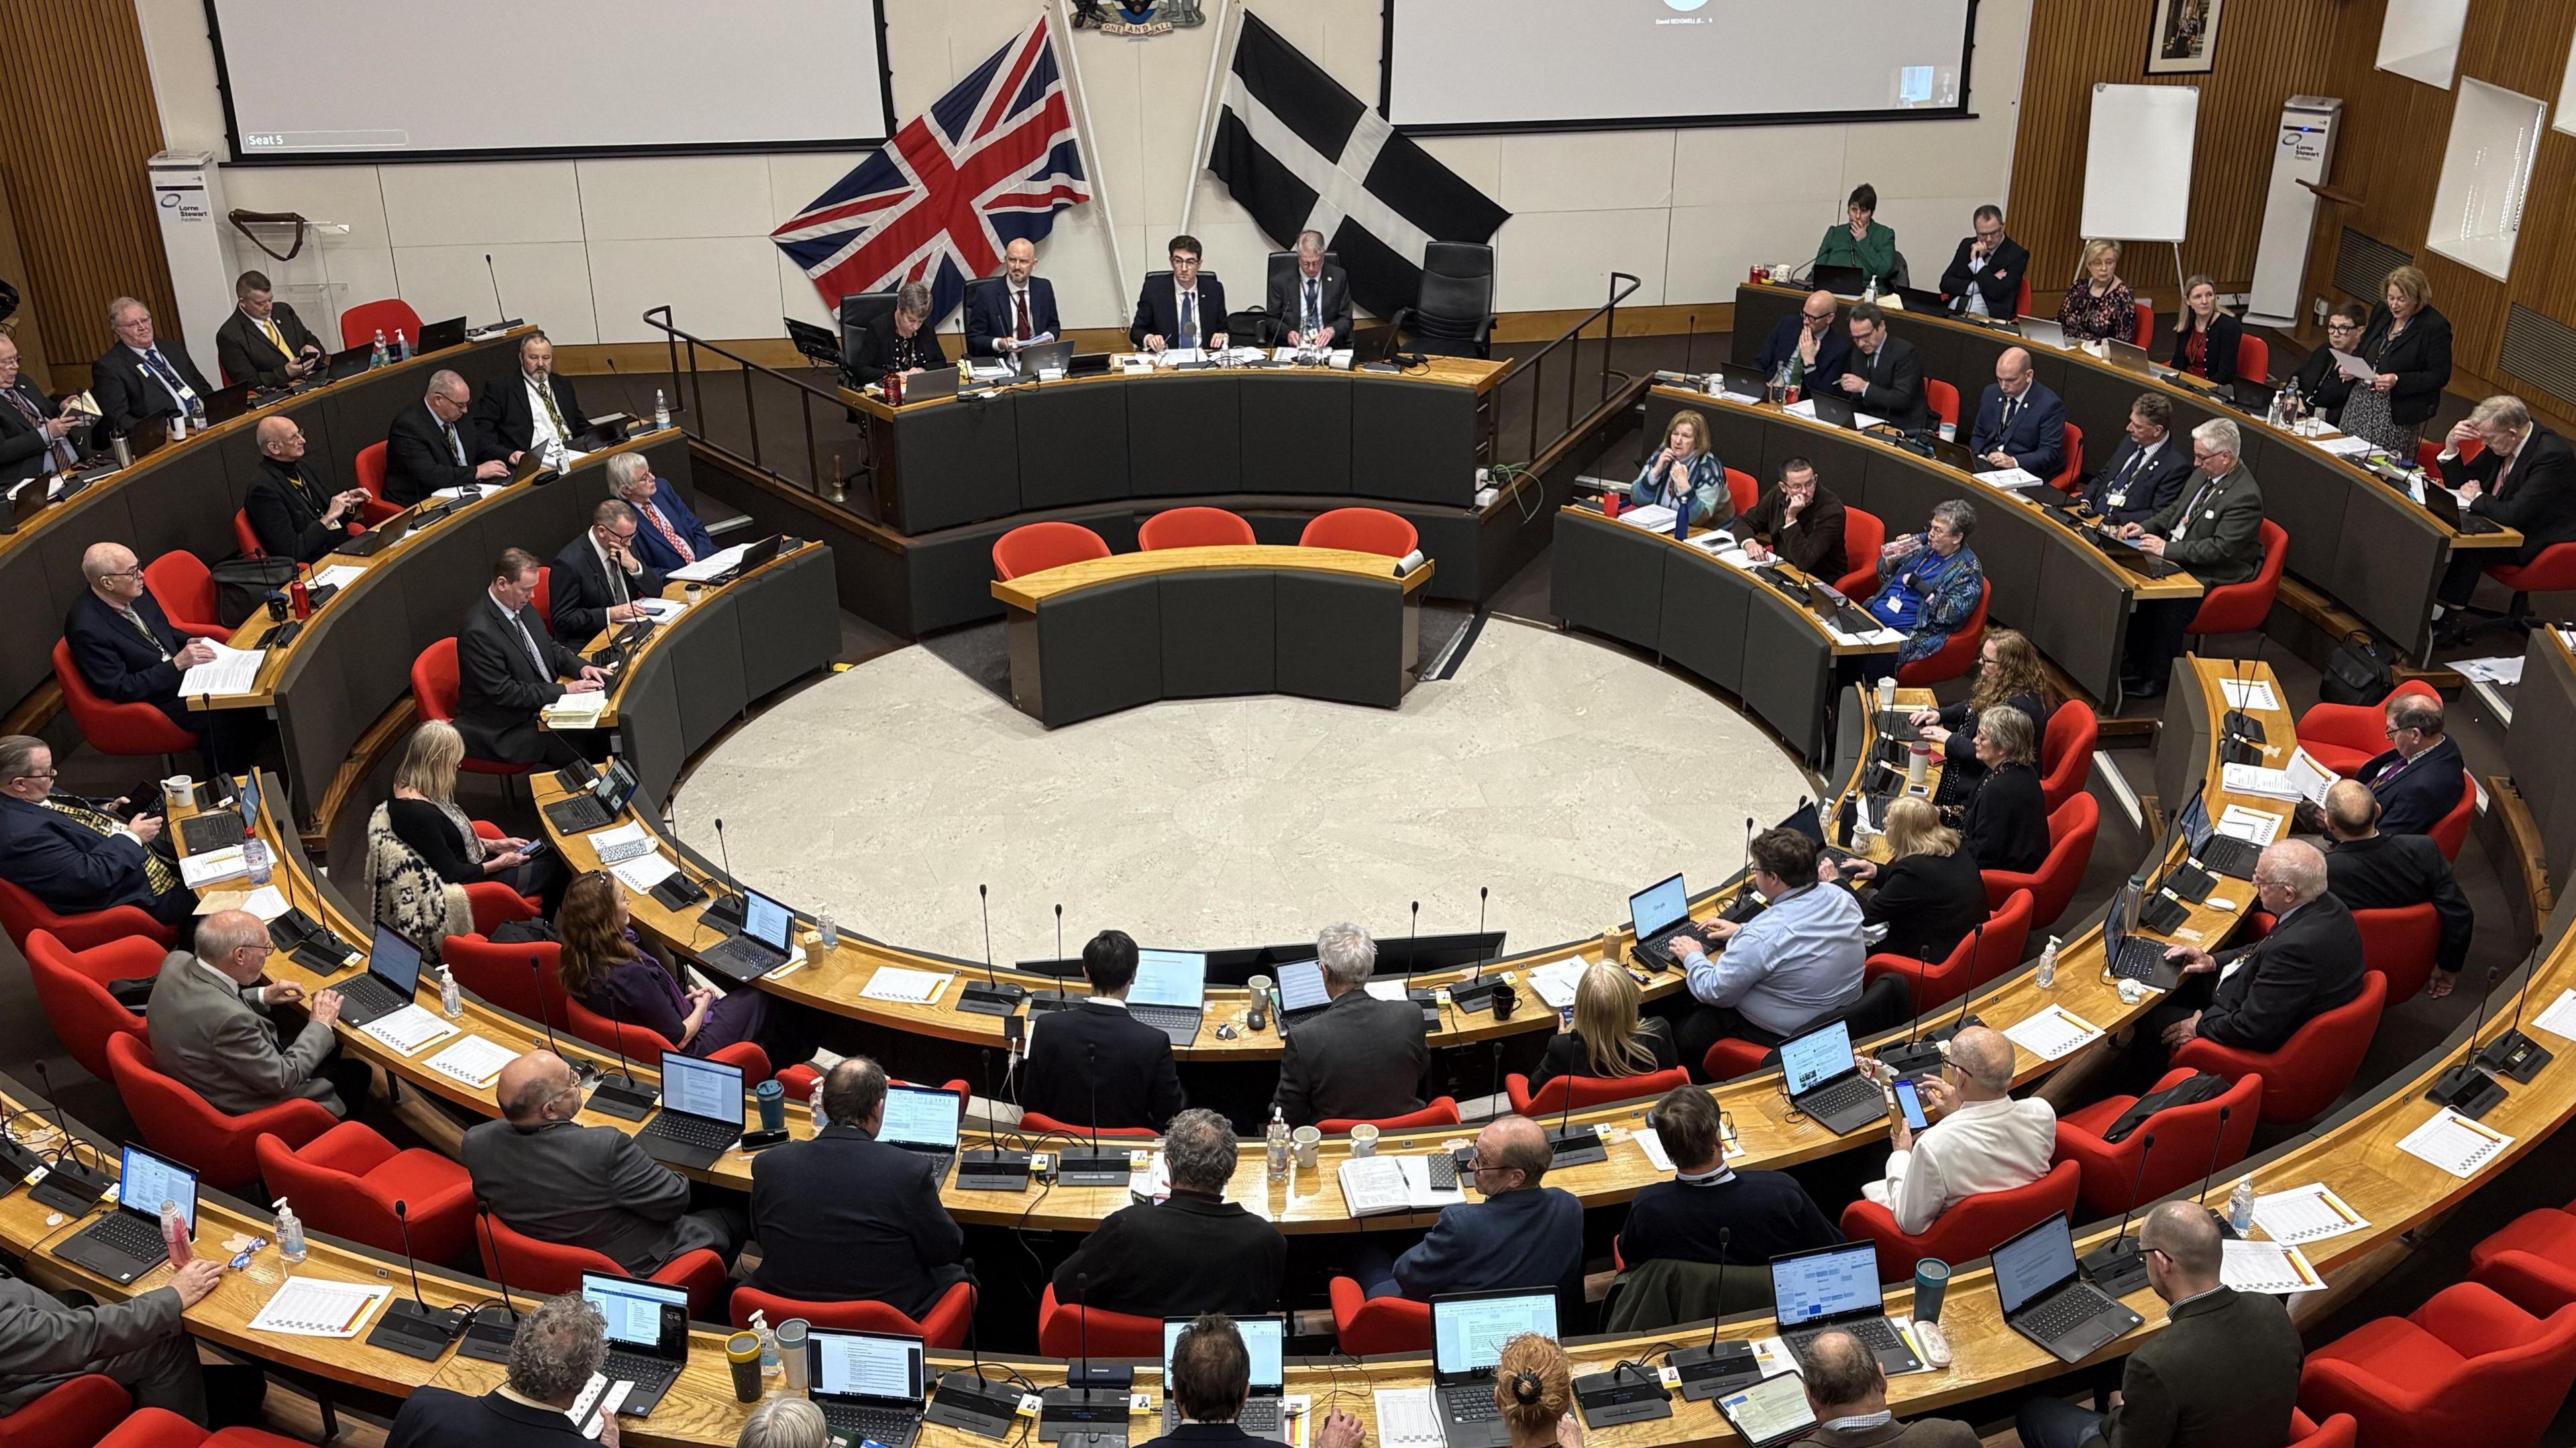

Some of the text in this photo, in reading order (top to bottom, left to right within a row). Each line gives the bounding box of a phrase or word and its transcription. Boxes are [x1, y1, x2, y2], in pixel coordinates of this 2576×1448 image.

[1105, 23, 1171, 33] ONE AND ALL
[248, 135, 284, 146] Seat 5
[2296, 150, 2319, 158] Stewart
